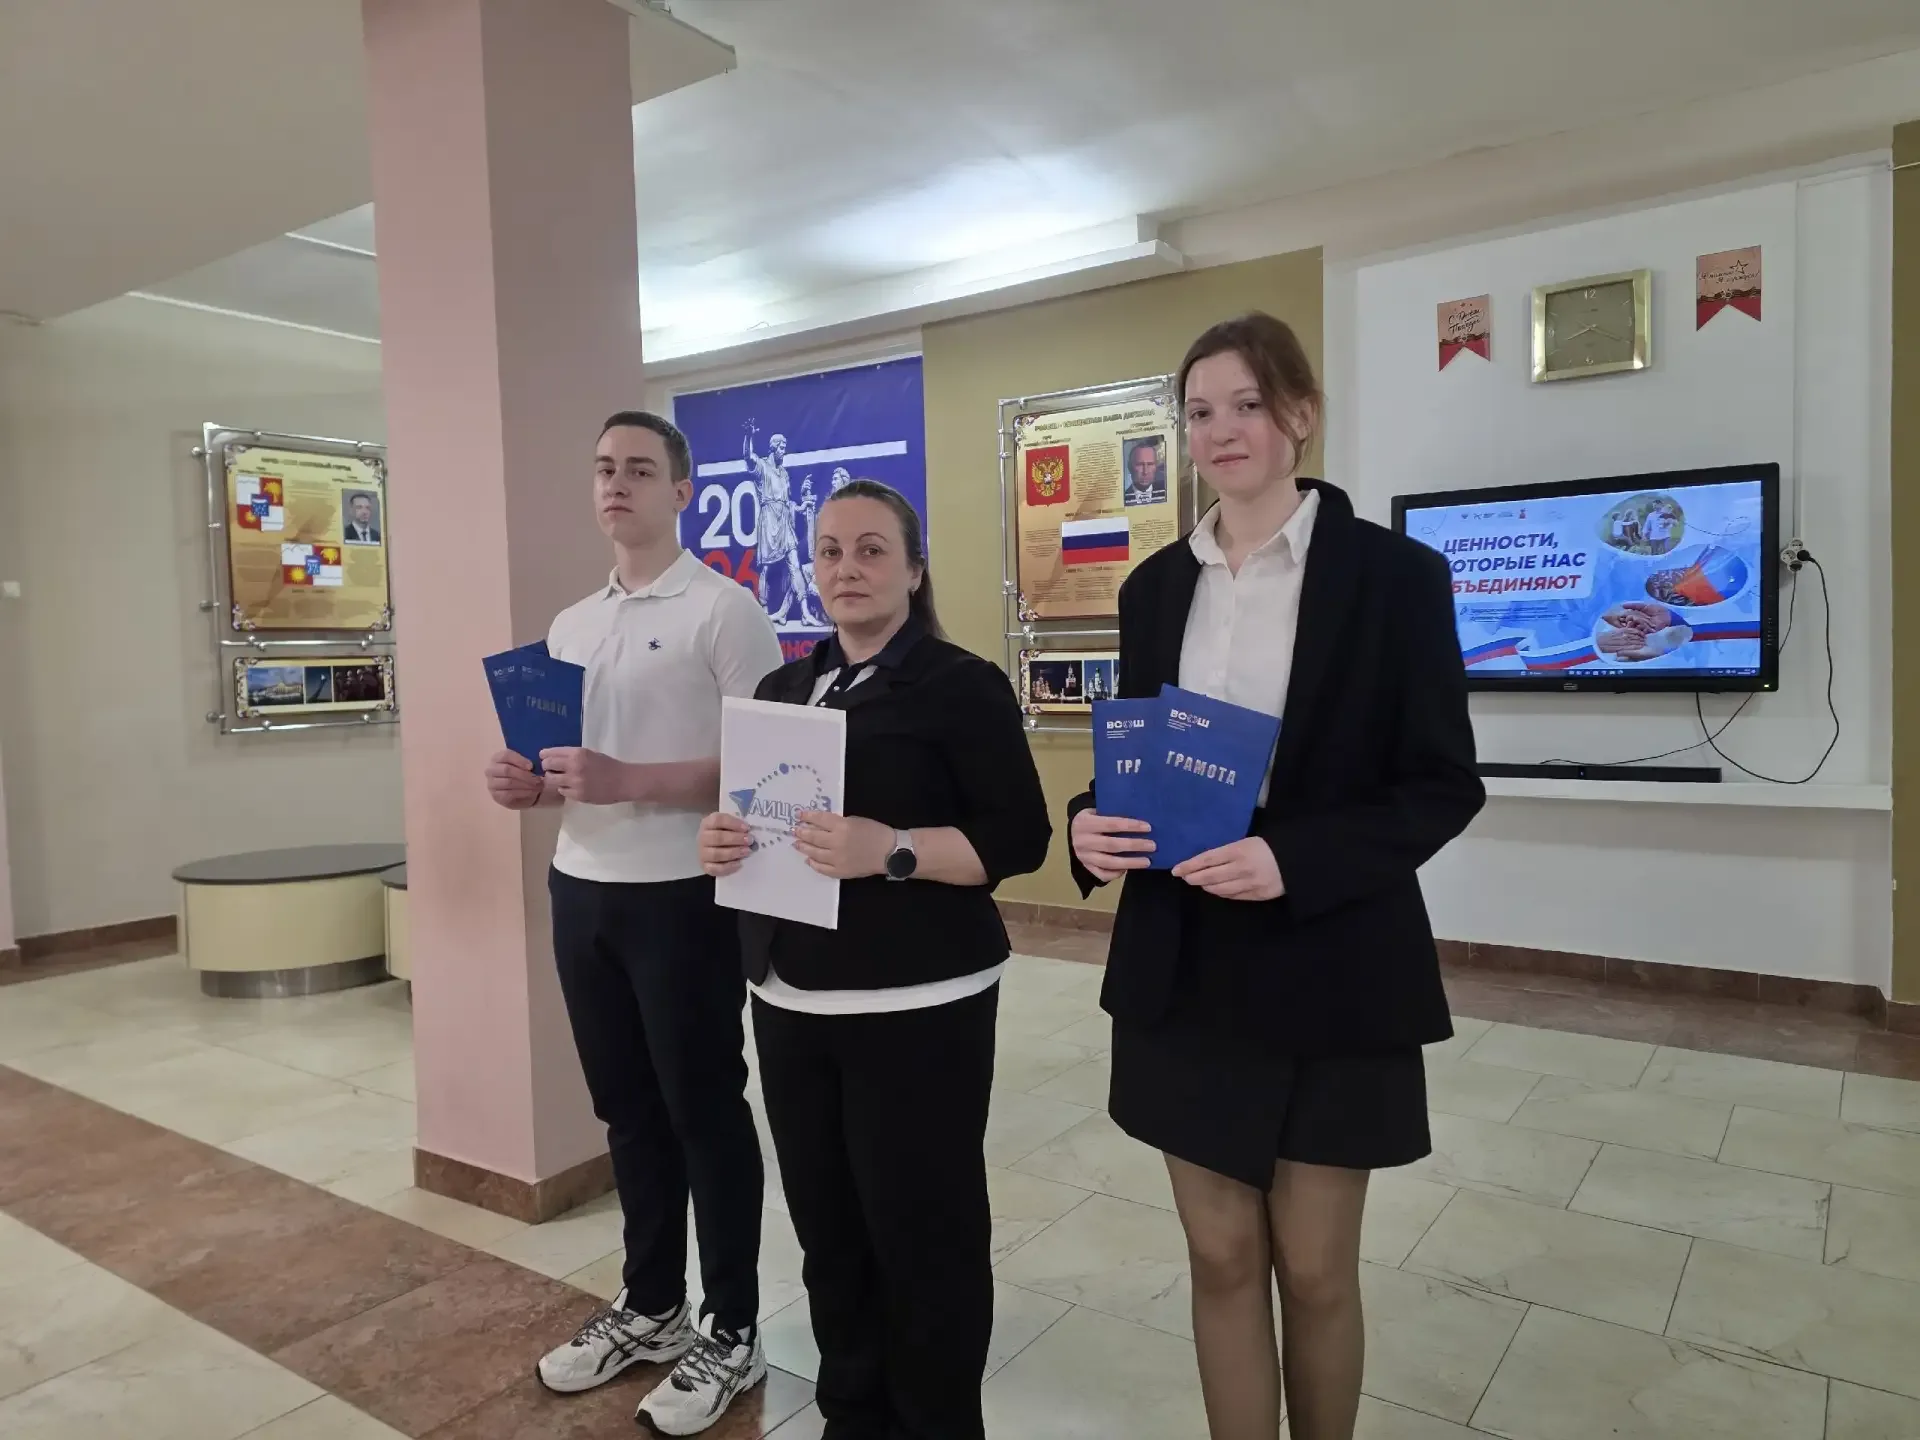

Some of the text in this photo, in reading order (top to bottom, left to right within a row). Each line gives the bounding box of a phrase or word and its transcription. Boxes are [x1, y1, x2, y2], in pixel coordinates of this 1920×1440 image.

[1583, 288, 1597, 299] 12
[698, 480, 760, 549] 20
[1443, 532, 1559, 554] ЦЕННОСТИ,
[1541, 552, 1587, 568] НАС
[1452, 574, 1582, 594] БЪЕДИНЯЮТ
[1165, 750, 1237, 786] ГРАМОТА
